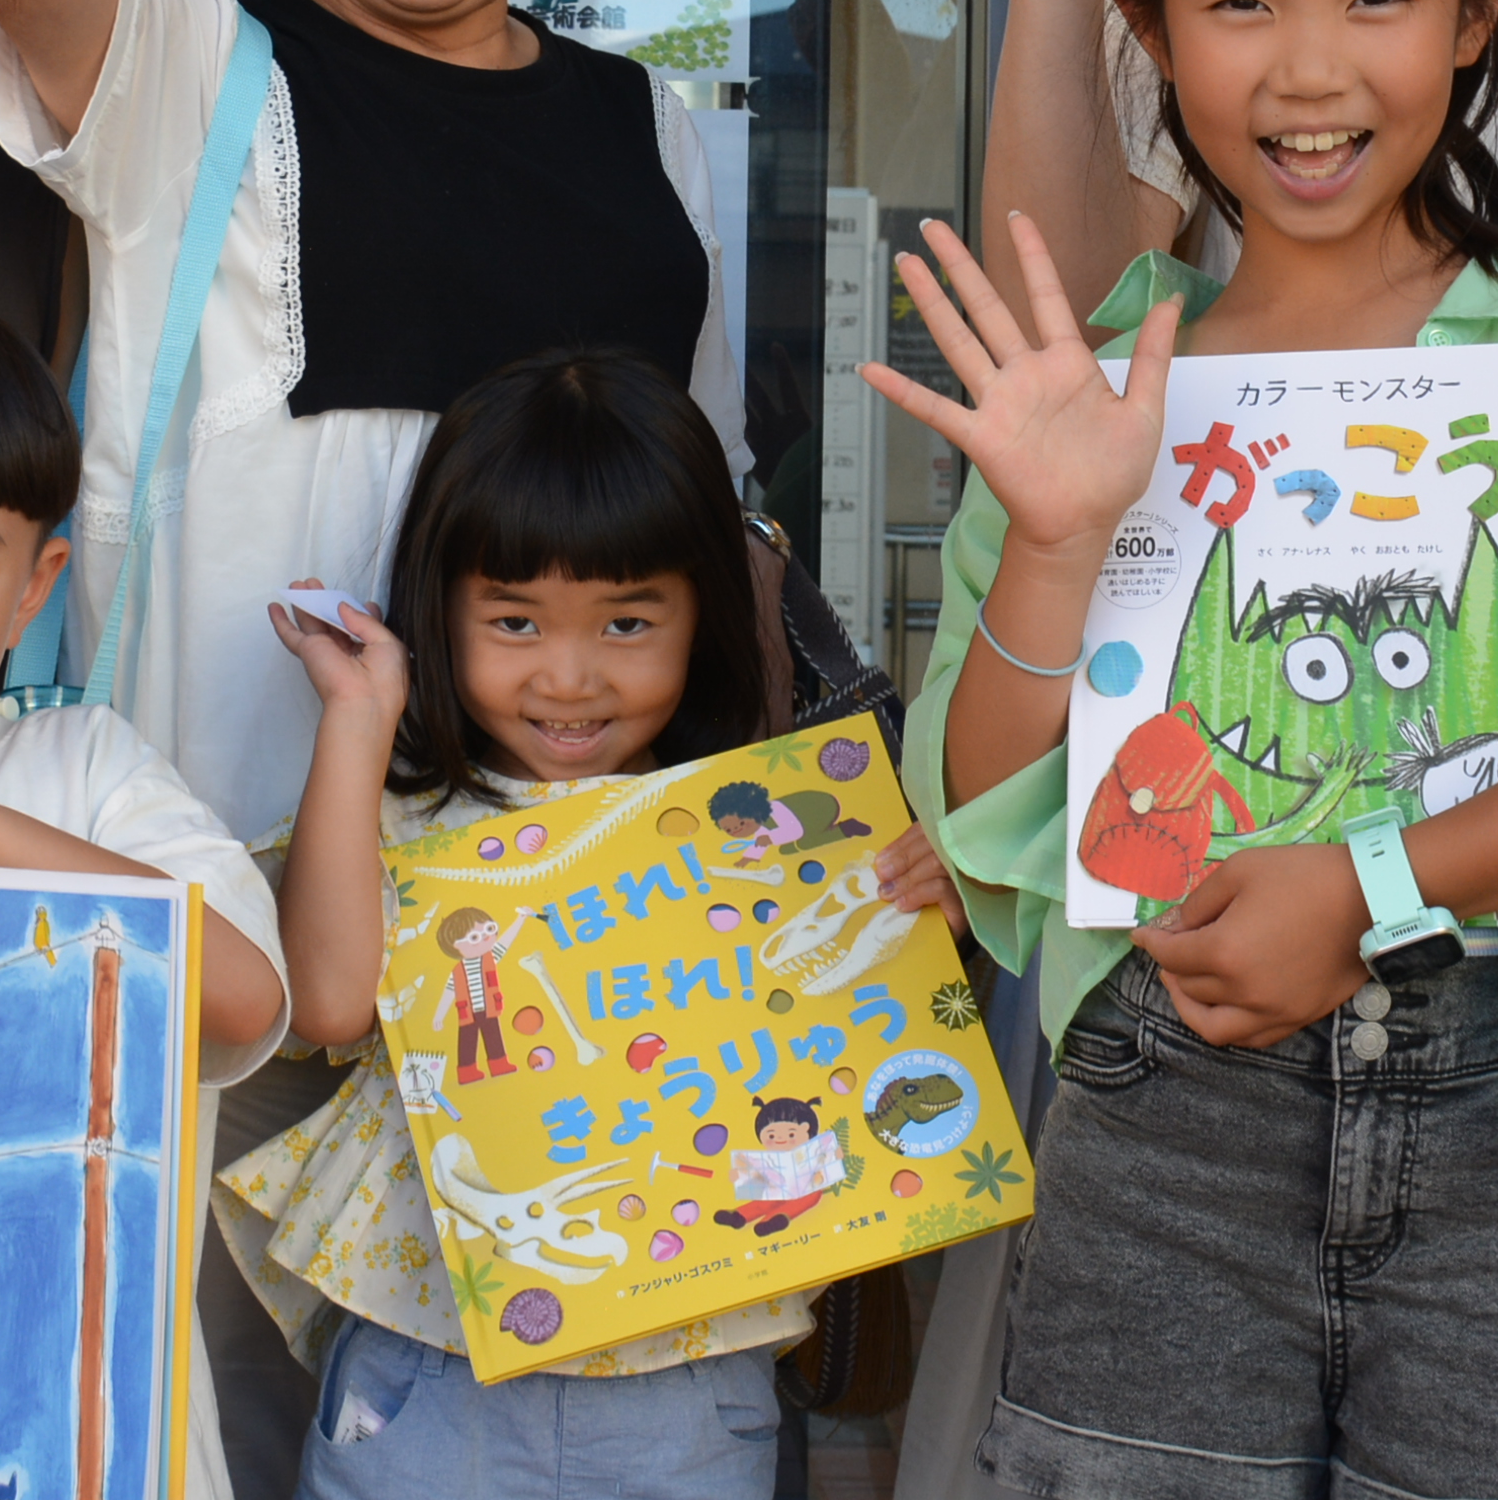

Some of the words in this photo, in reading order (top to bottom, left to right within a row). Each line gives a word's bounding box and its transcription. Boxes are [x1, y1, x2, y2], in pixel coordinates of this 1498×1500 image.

[540, 983, 908, 1165] きょうりゅう
